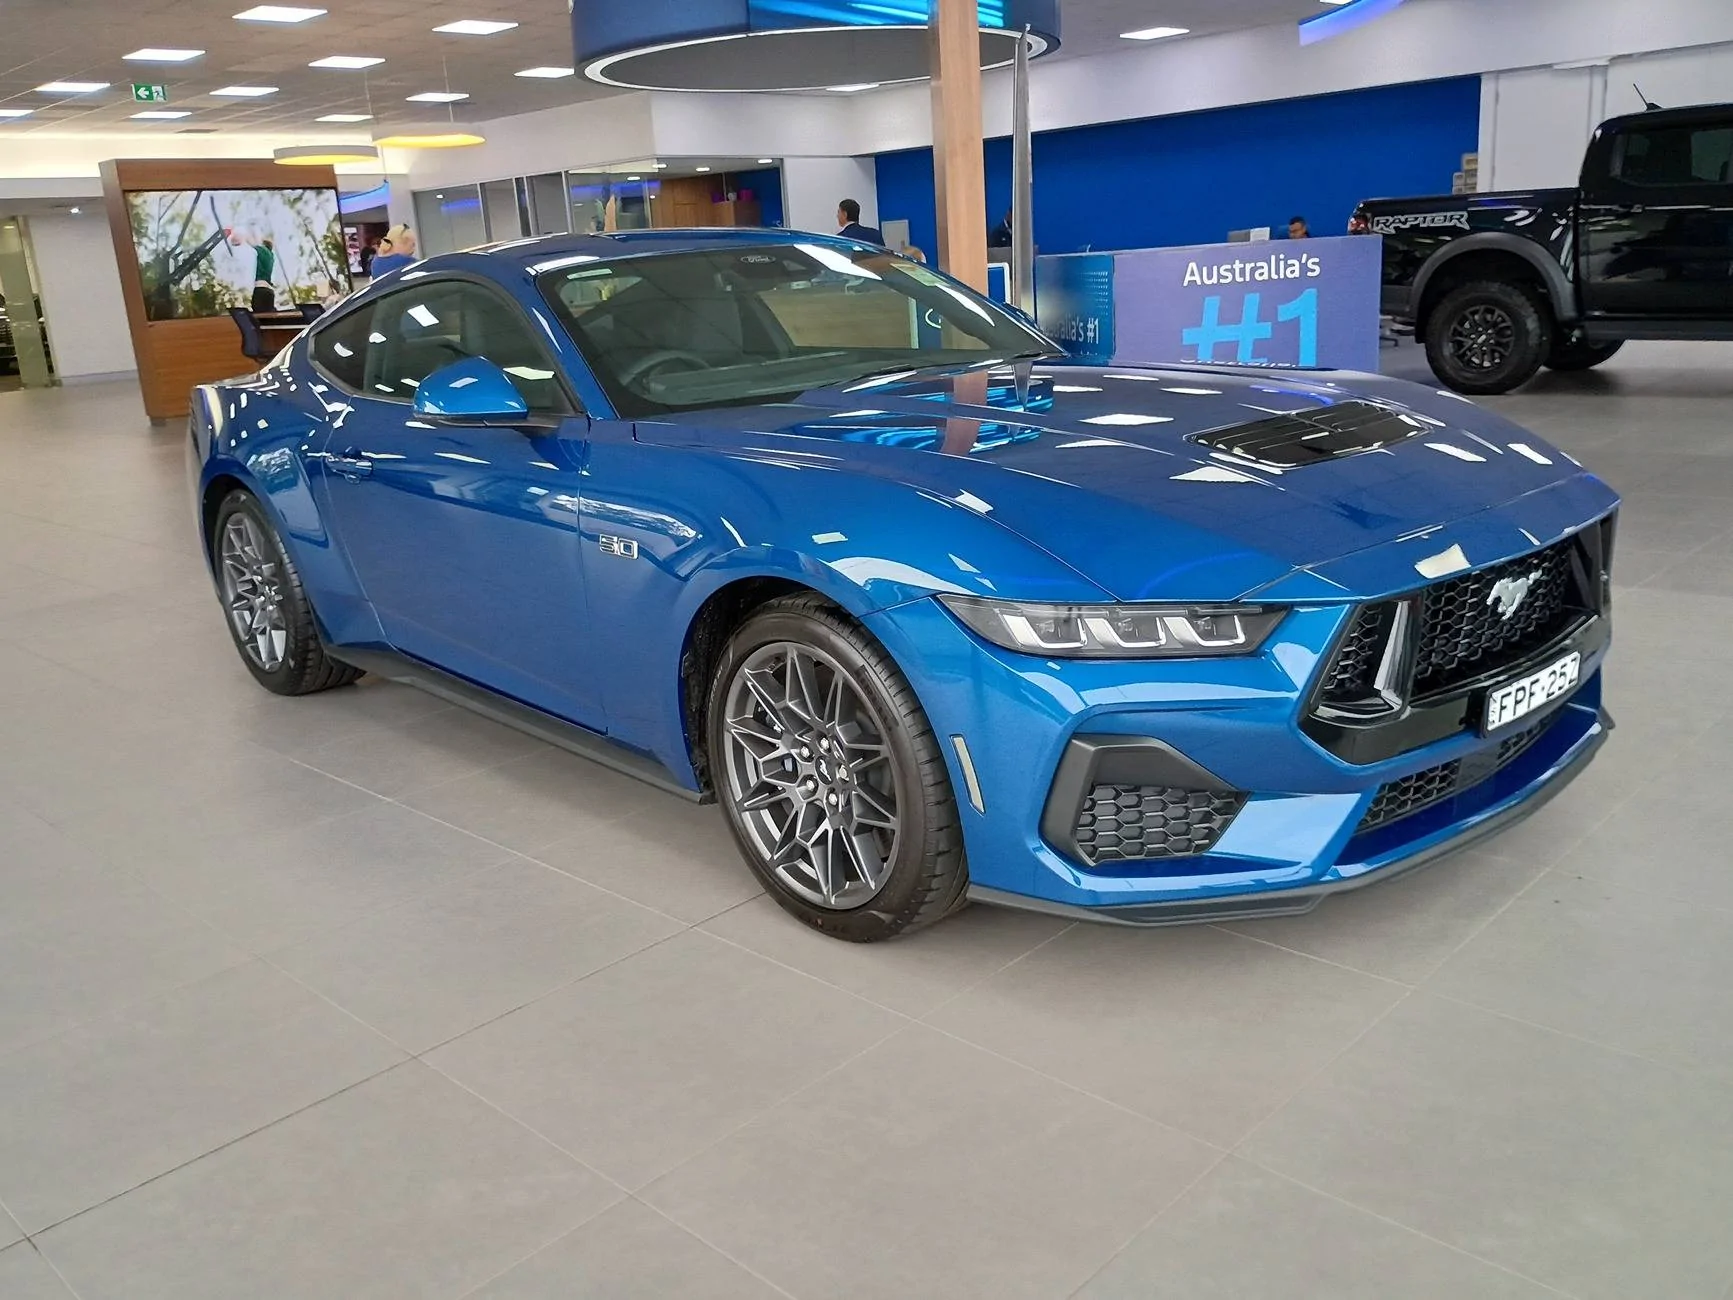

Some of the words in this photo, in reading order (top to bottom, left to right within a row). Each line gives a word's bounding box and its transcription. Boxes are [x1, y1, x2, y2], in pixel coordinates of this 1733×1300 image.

[1373, 211, 1470, 234] RAPTOR
[1183, 253, 1321, 287] Australia's
[1086, 317, 1099, 344] #1
[1182, 287, 1318, 367] #1
